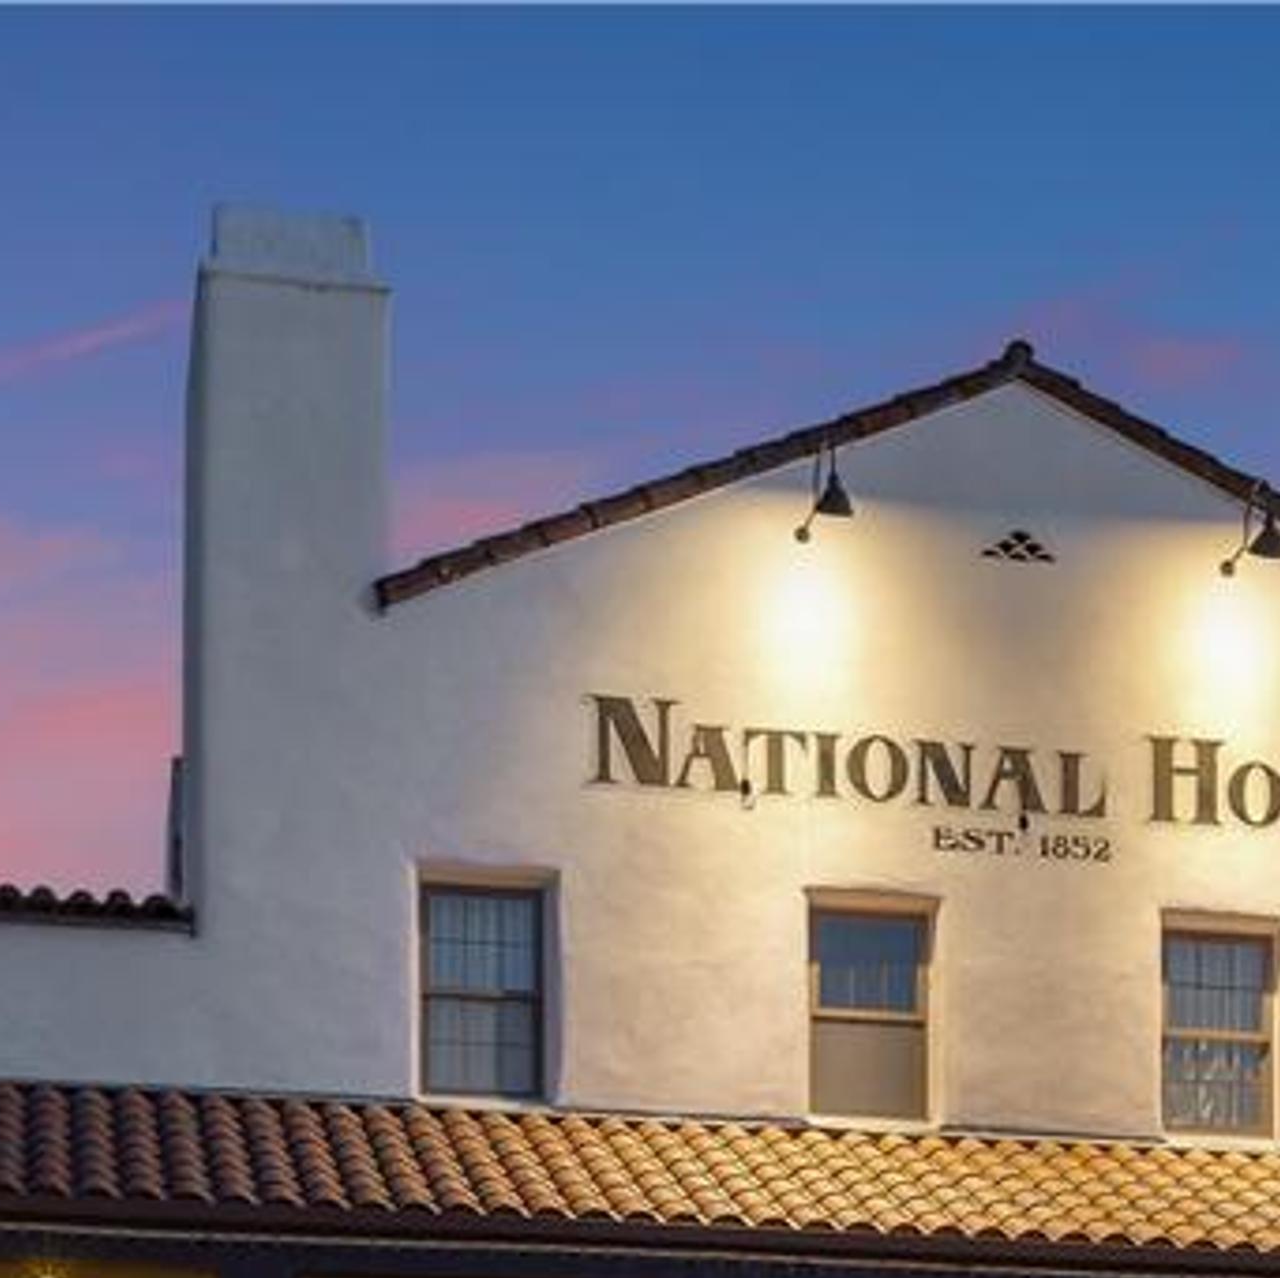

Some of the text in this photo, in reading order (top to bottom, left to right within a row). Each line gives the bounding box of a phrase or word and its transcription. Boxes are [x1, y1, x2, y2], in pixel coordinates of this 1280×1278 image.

[584, 694, 1108, 818] NATIONAL
[931, 827, 1112, 862] EST. 1852
